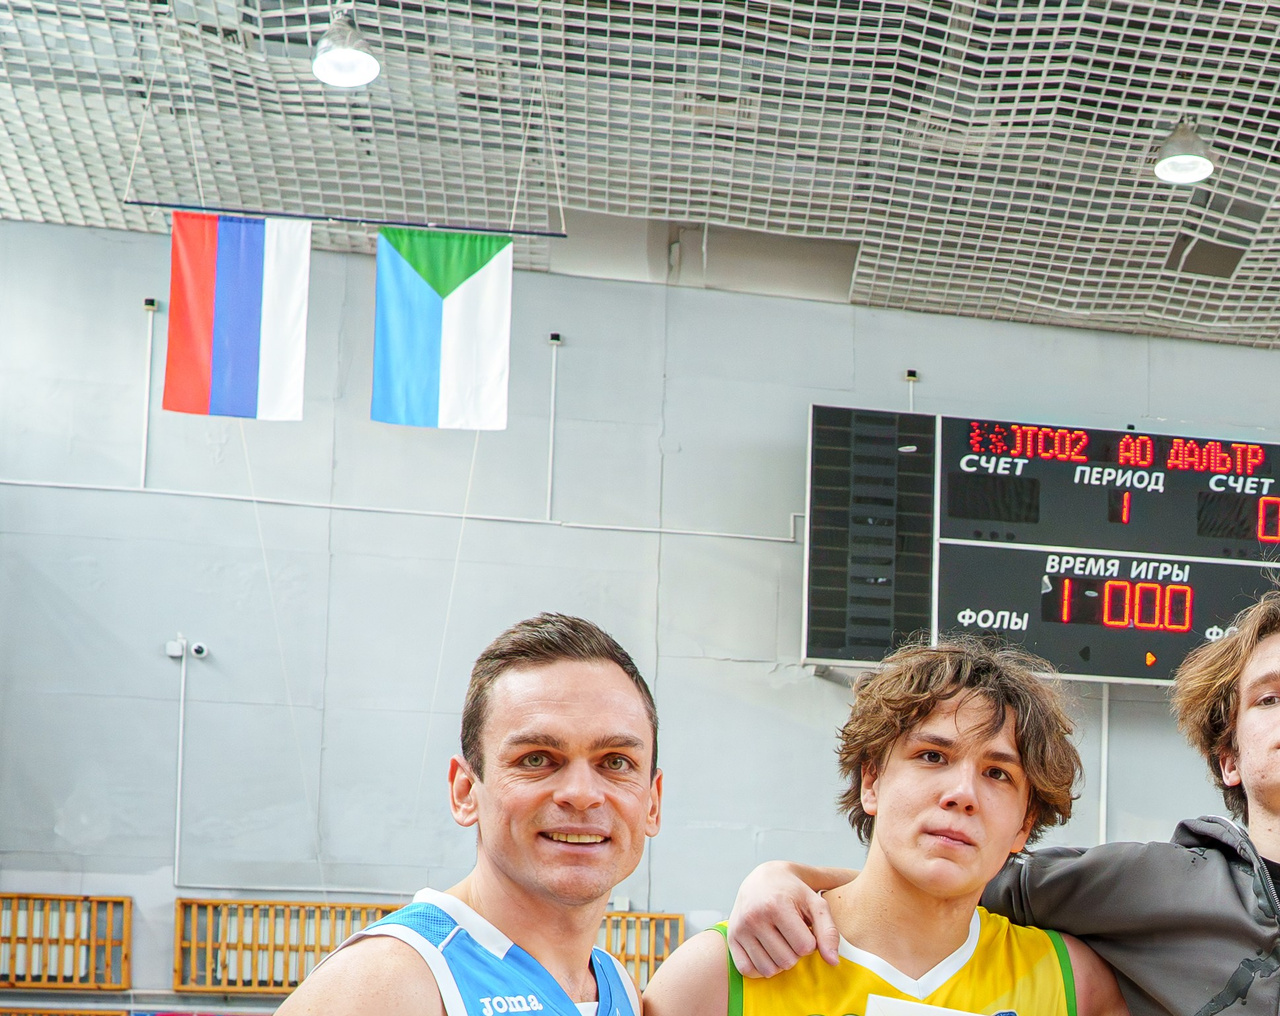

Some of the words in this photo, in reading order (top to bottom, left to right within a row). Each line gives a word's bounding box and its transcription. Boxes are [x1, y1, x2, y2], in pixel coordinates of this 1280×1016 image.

[1119, 434, 1153, 467] АО
[959, 454, 1029, 476] СЧЕТ
[1073, 465, 1165, 493] ПЕРИОД
[1208, 474, 1275, 495] СЧЕТ
[1121, 492, 1131, 524] 1
[1045, 555, 1119, 578] ВРЕМЯ
[1130, 560, 1190, 583] ИГРЫ
[957, 608, 1029, 631] ФОЛЫ
